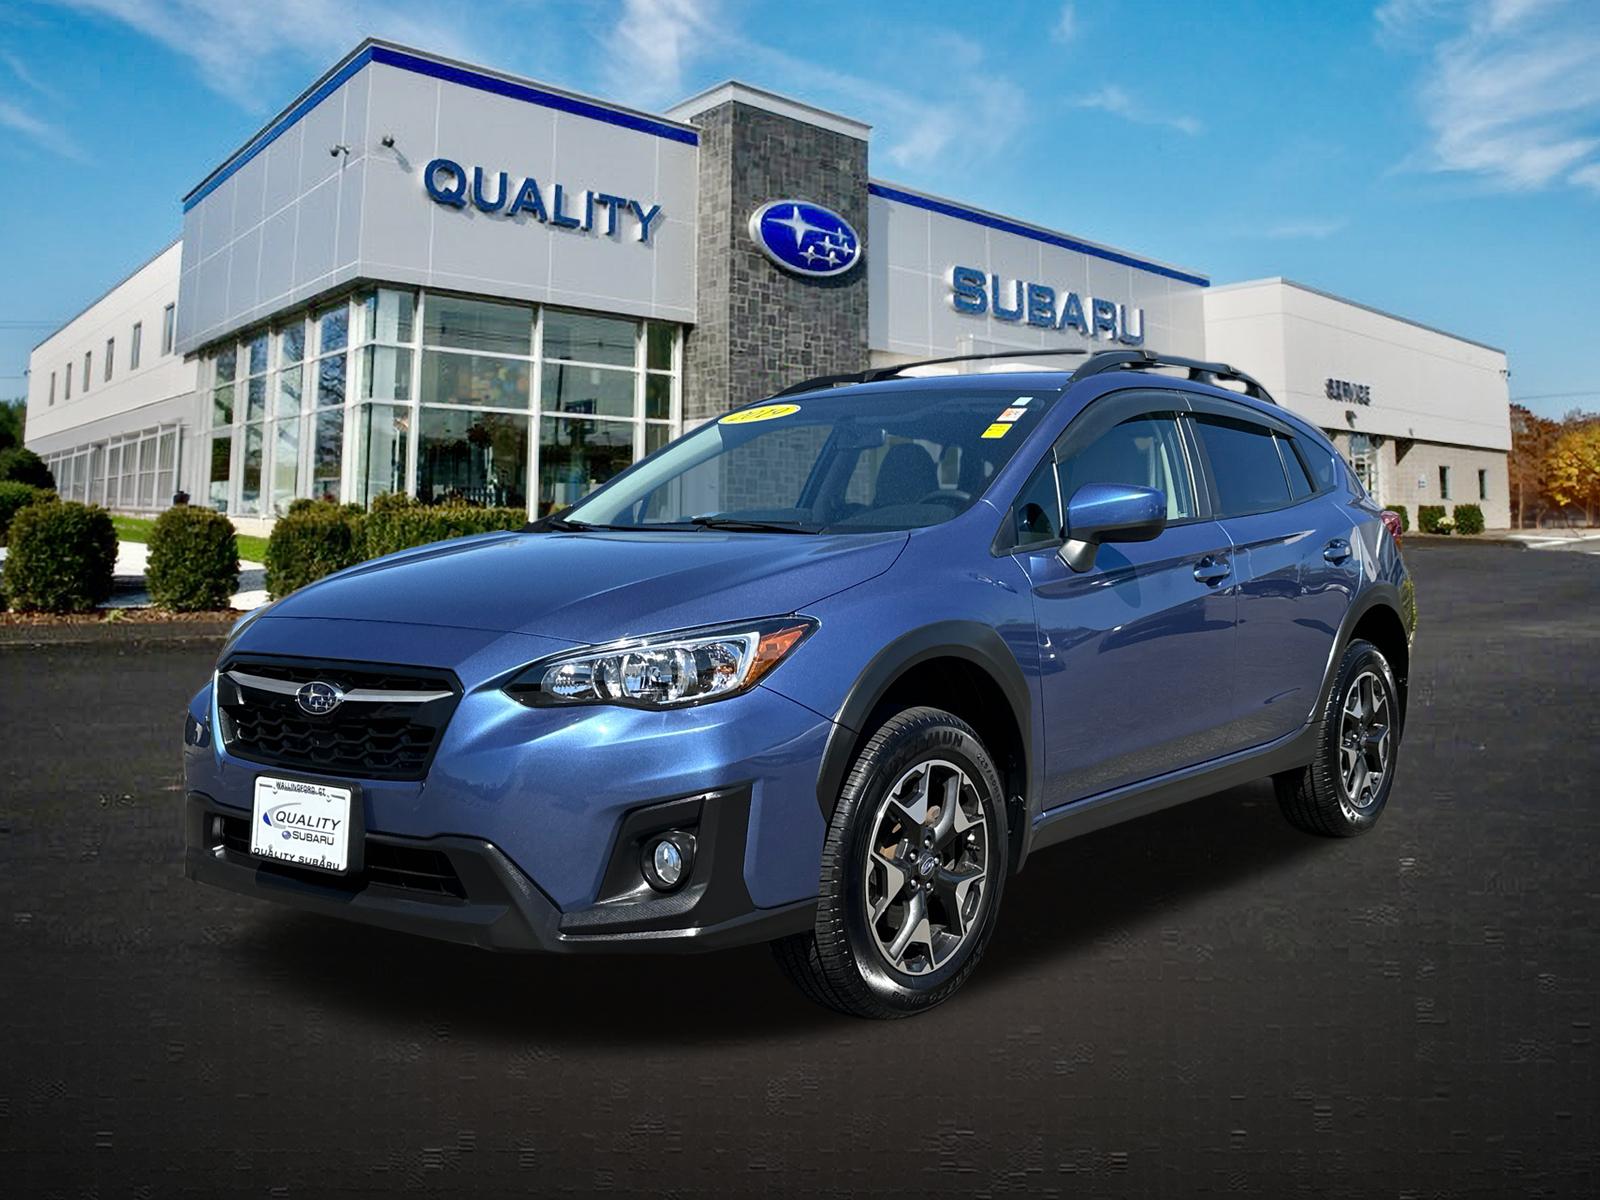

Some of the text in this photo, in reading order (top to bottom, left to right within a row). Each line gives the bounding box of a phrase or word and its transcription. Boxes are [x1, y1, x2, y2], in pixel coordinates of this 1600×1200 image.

[424, 158, 662, 243] QUALITY
[950, 265, 1145, 346] SUBARU
[1325, 378, 1371, 406] SERVICE
[276, 811, 341, 831] QUALITY
[292, 831, 334, 846] SUBARU
[253, 847, 340, 870] QUALITY SUBARU
